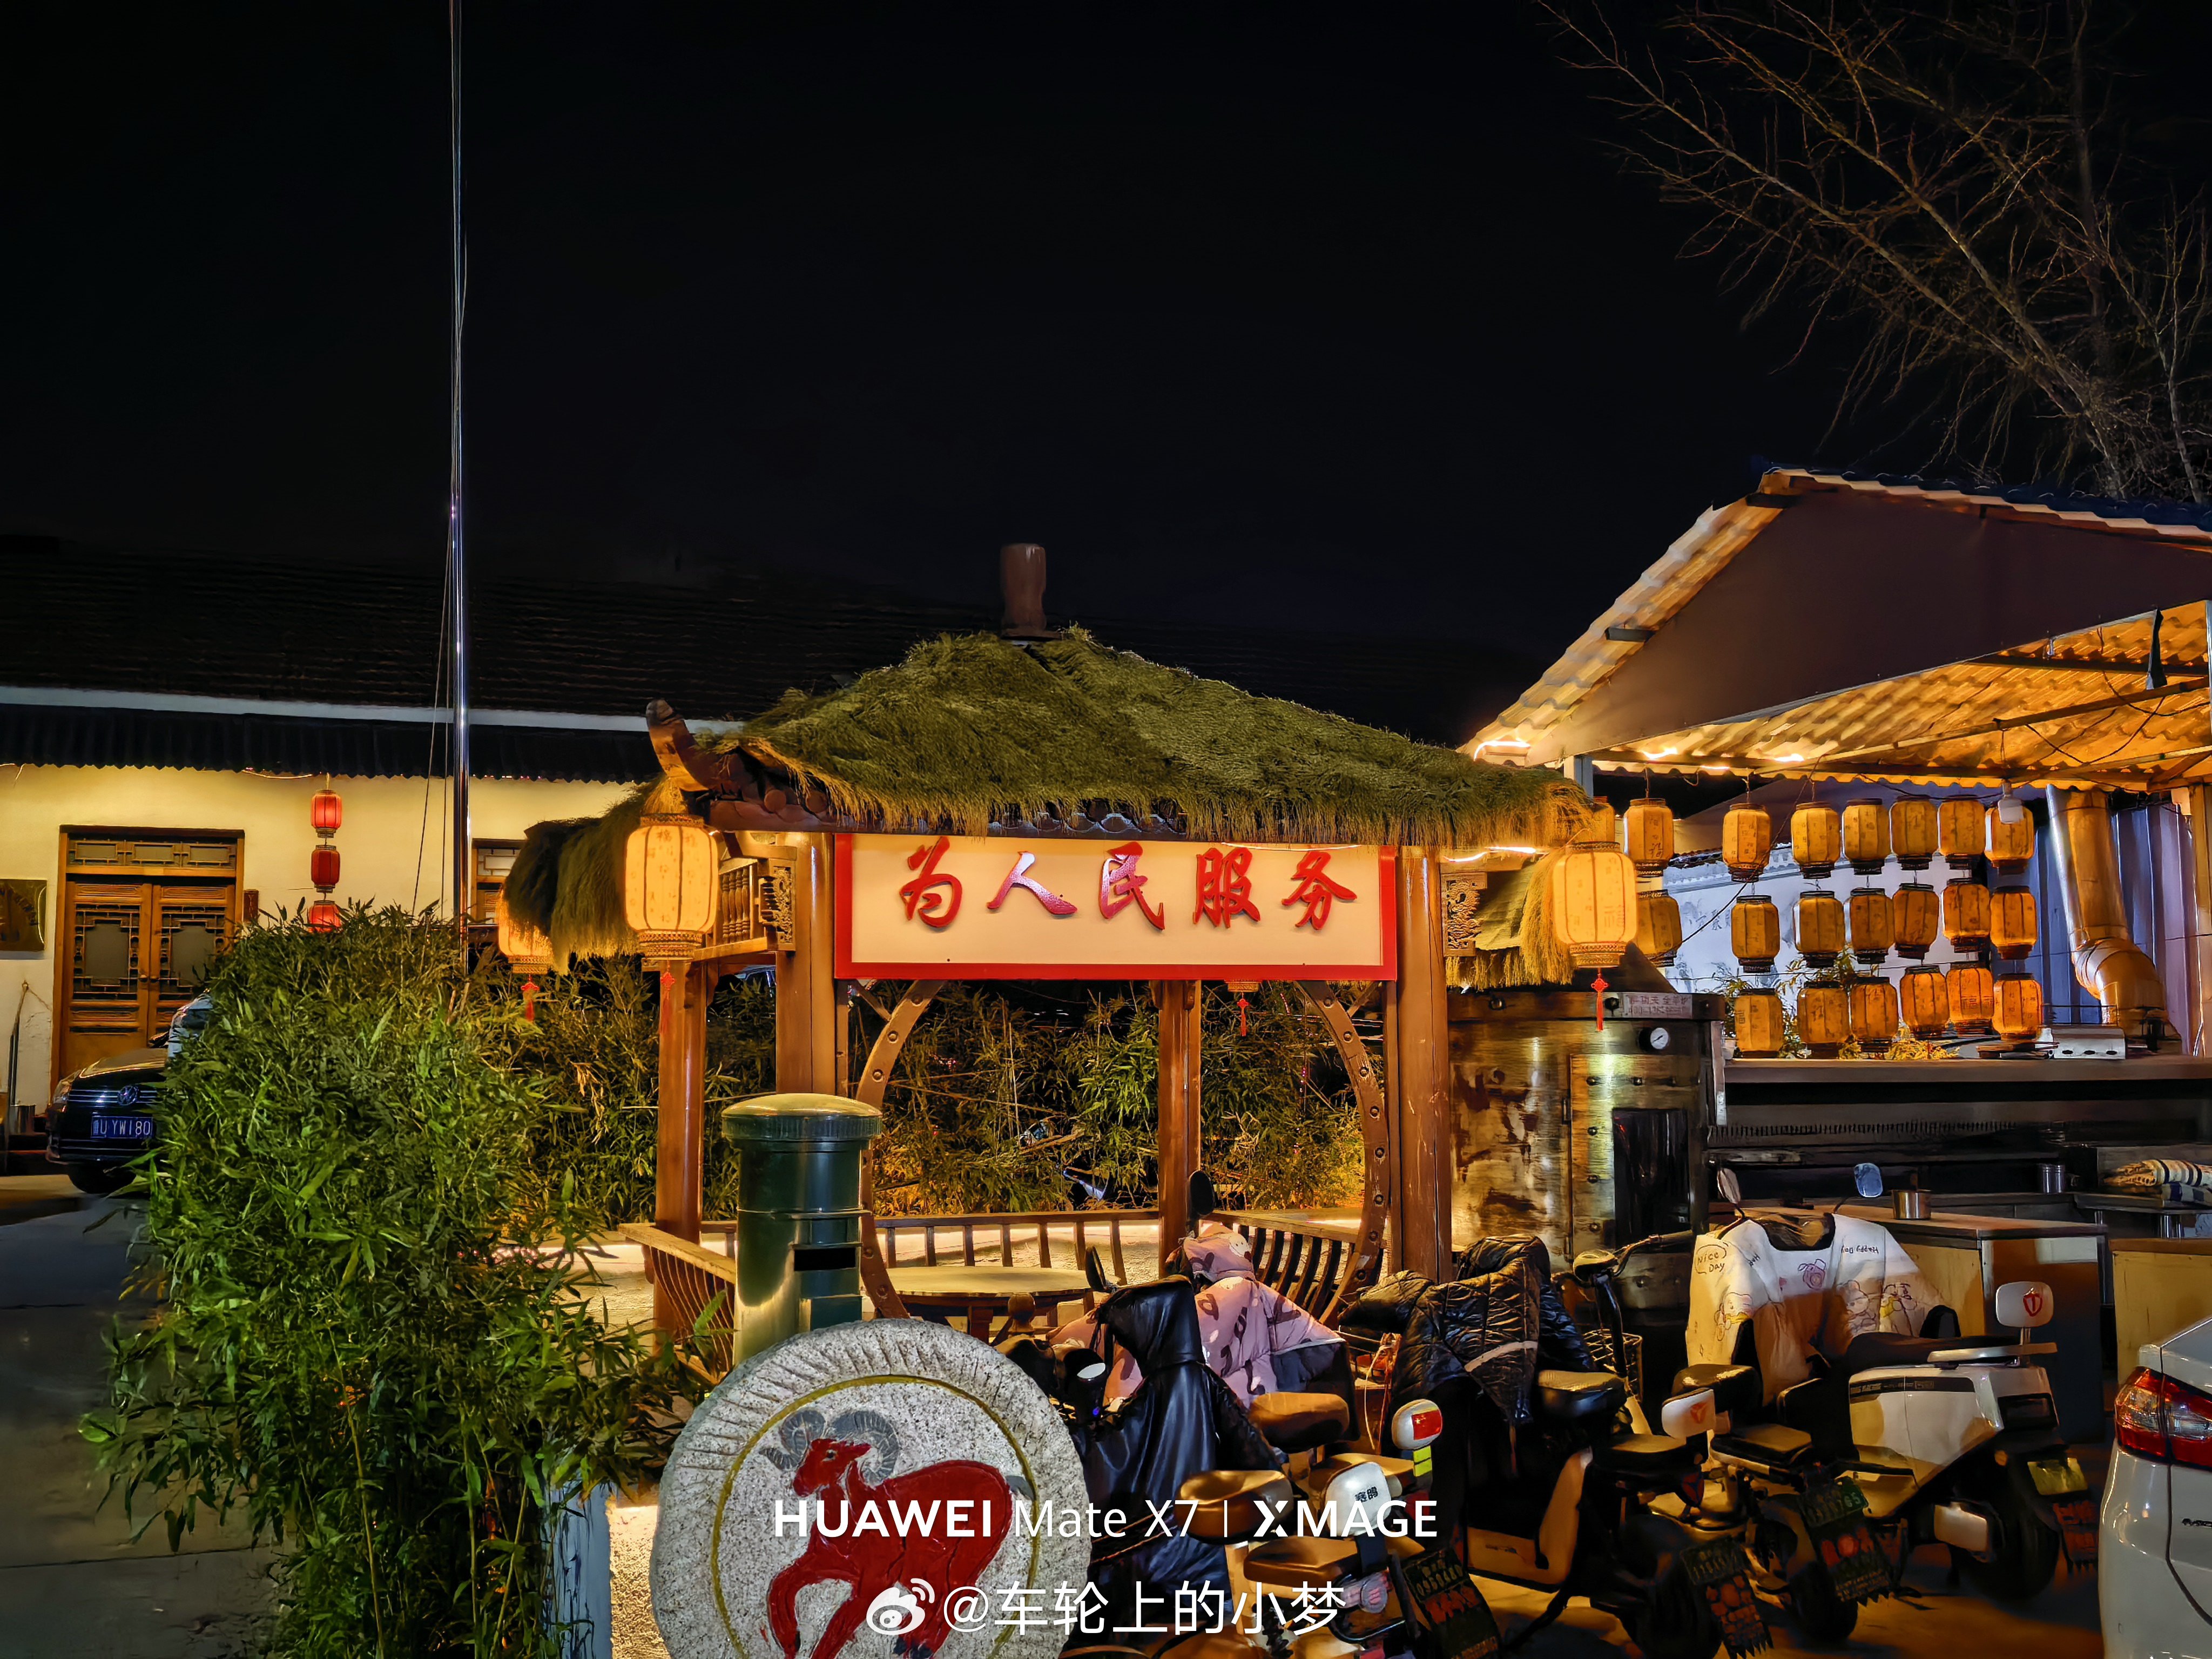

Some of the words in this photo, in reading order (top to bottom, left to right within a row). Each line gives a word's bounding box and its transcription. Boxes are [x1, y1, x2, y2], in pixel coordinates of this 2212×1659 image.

[900, 837, 1357, 930] 为人民服务
